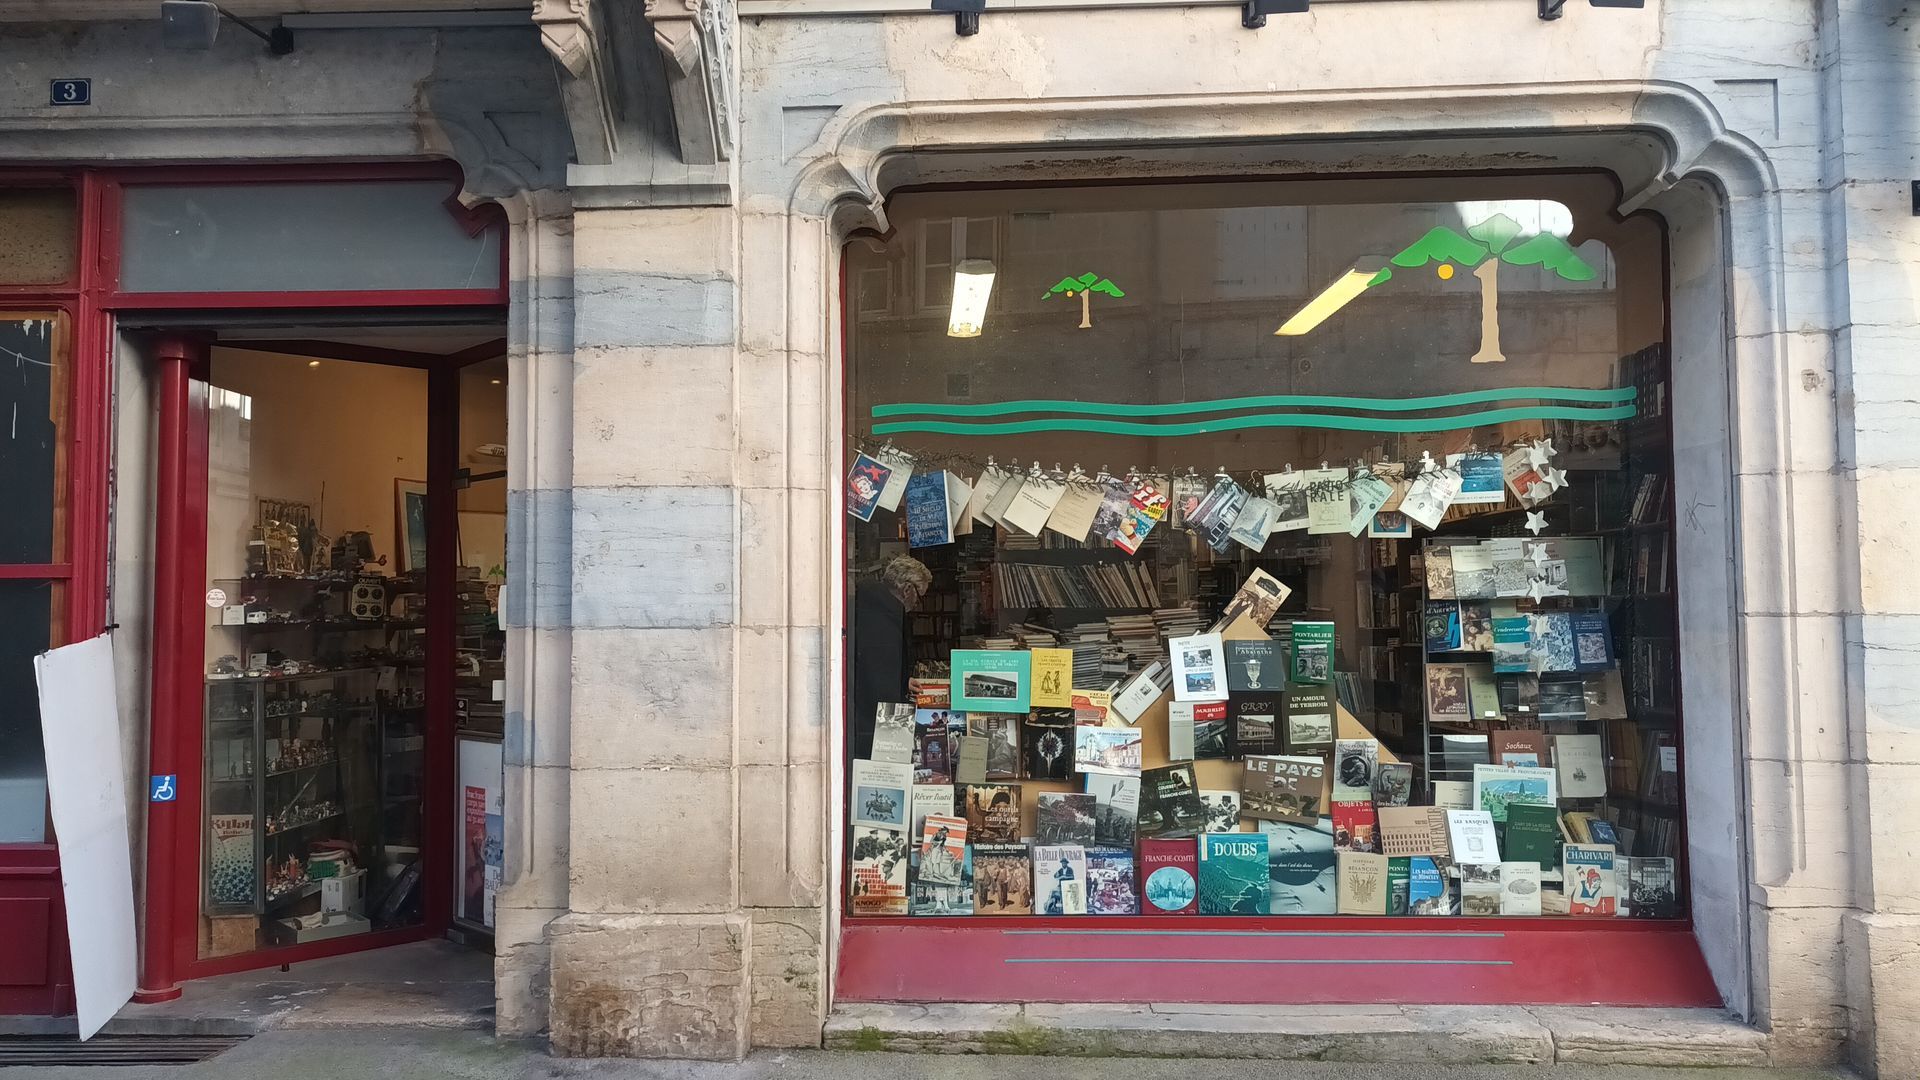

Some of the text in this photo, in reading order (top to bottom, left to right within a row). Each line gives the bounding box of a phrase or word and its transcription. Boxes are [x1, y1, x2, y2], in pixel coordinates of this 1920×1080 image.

[63, 82, 77, 101] 3
[1310, 491, 1344, 503] RALE
[358, 577, 382, 586] OUVERT
[1240, 702, 1272, 712] GRAY
[1505, 741, 1534, 750] Sochaux
[1247, 760, 1323, 778] LE PAYS
[1274, 776, 1298, 790] DE
[985, 816, 1018, 826] campagne
[1034, 850, 1041, 861] LA
[1042, 848, 1058, 861] BELLE
[1059, 848, 1082, 861] OUVRAGE
[1214, 842, 1258, 856] DOUBS
[1566, 850, 1612, 861] CHARIVARI
